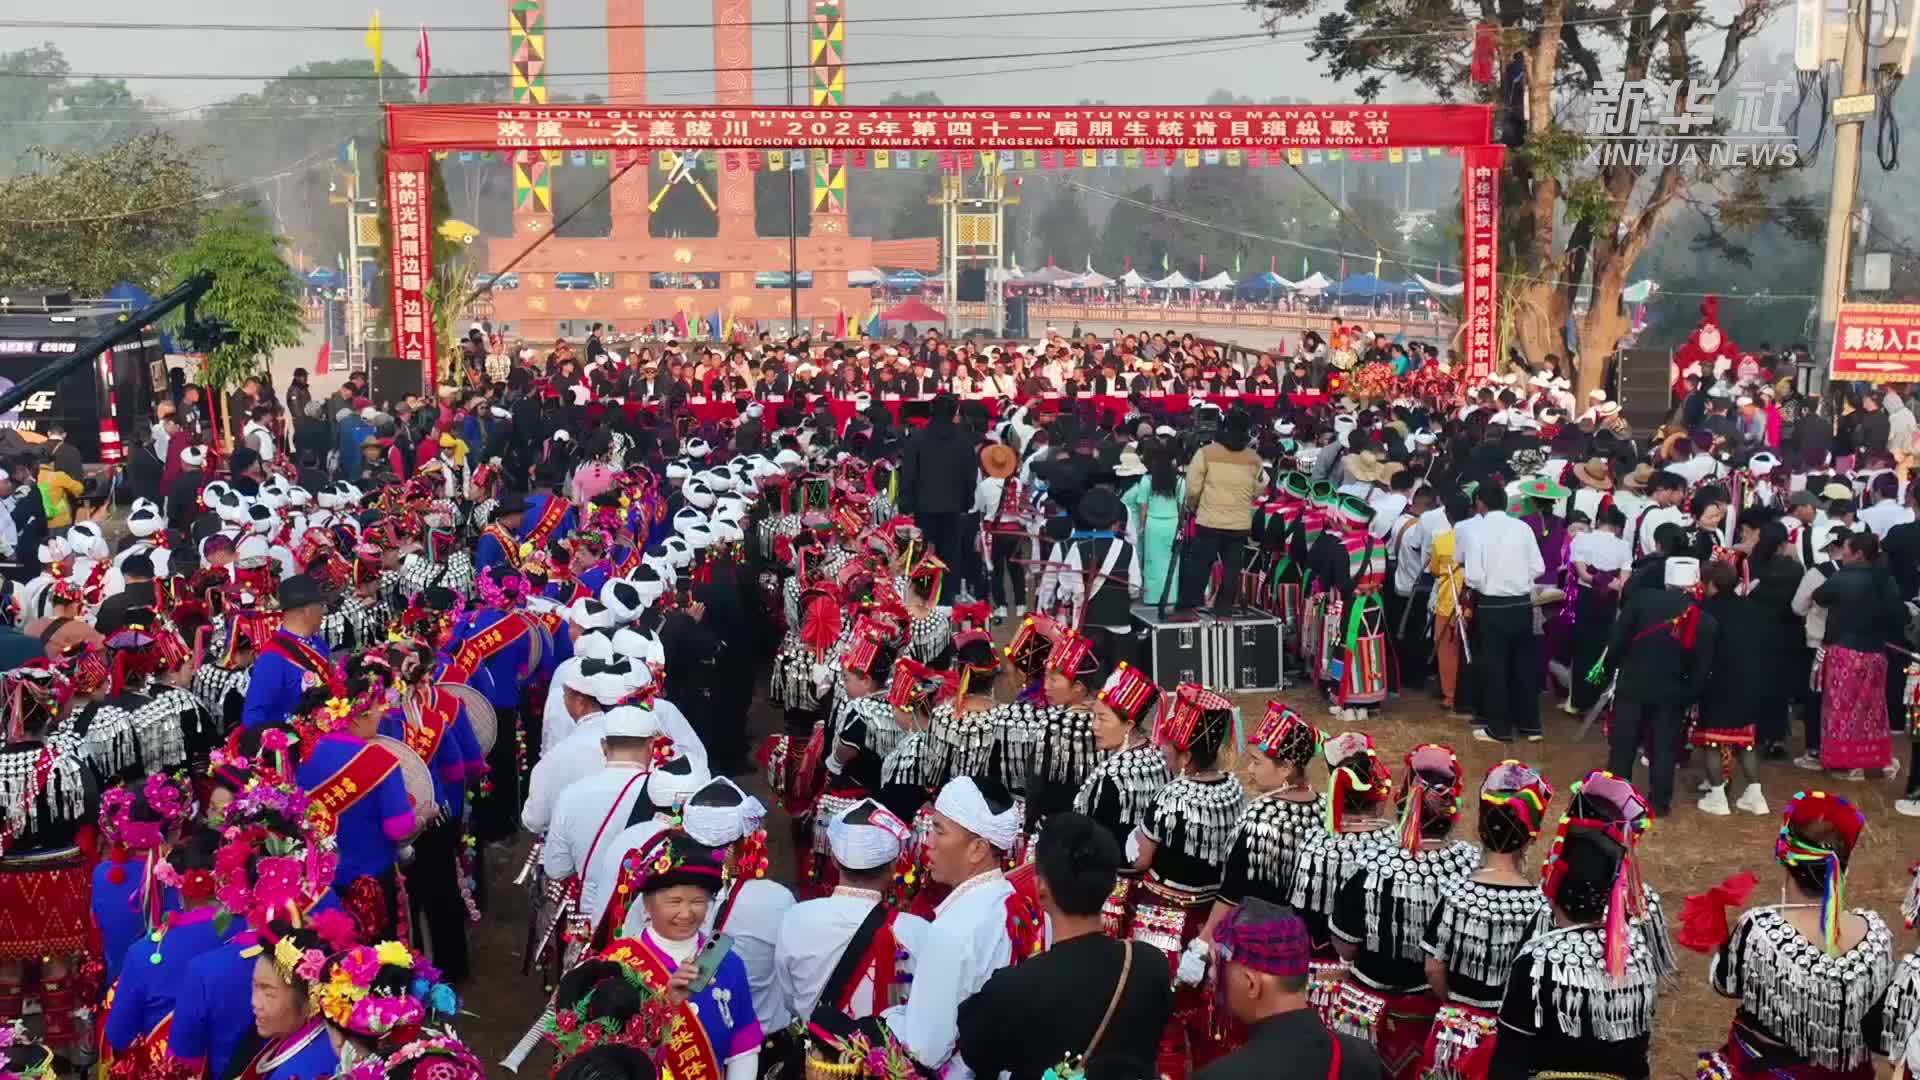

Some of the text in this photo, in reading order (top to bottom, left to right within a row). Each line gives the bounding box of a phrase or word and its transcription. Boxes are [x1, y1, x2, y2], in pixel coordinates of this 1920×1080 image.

[607, 111, 736, 119] GINWANG
[751, 111, 853, 119] NINGDO
[868, 111, 892, 119] 41
[908, 111, 995, 119] HPUNG
[1009, 111, 1051, 119] SIN
[1065, 111, 1232, 119] HTUNGHKING
[1246, 111, 1335, 119] MANAU
[1348, 111, 1388, 119] POI
[576, 137, 609, 146] MYIT
[616, 137, 642, 146] MAI
[714, 138, 793, 146] LUNGCHON
[798, 138, 865, 146] GINWANG
[871, 138, 929, 146] NAMBAT
[1059, 137, 1128, 145] TUNGKING
[1134, 137, 1184, 145] MUNAU
[1188, 137, 1217, 145] ZUM
[1282, 137, 1320, 145] CHOM
[1325, 137, 1363, 145] NGON
[1368, 137, 1389, 145] LAI
